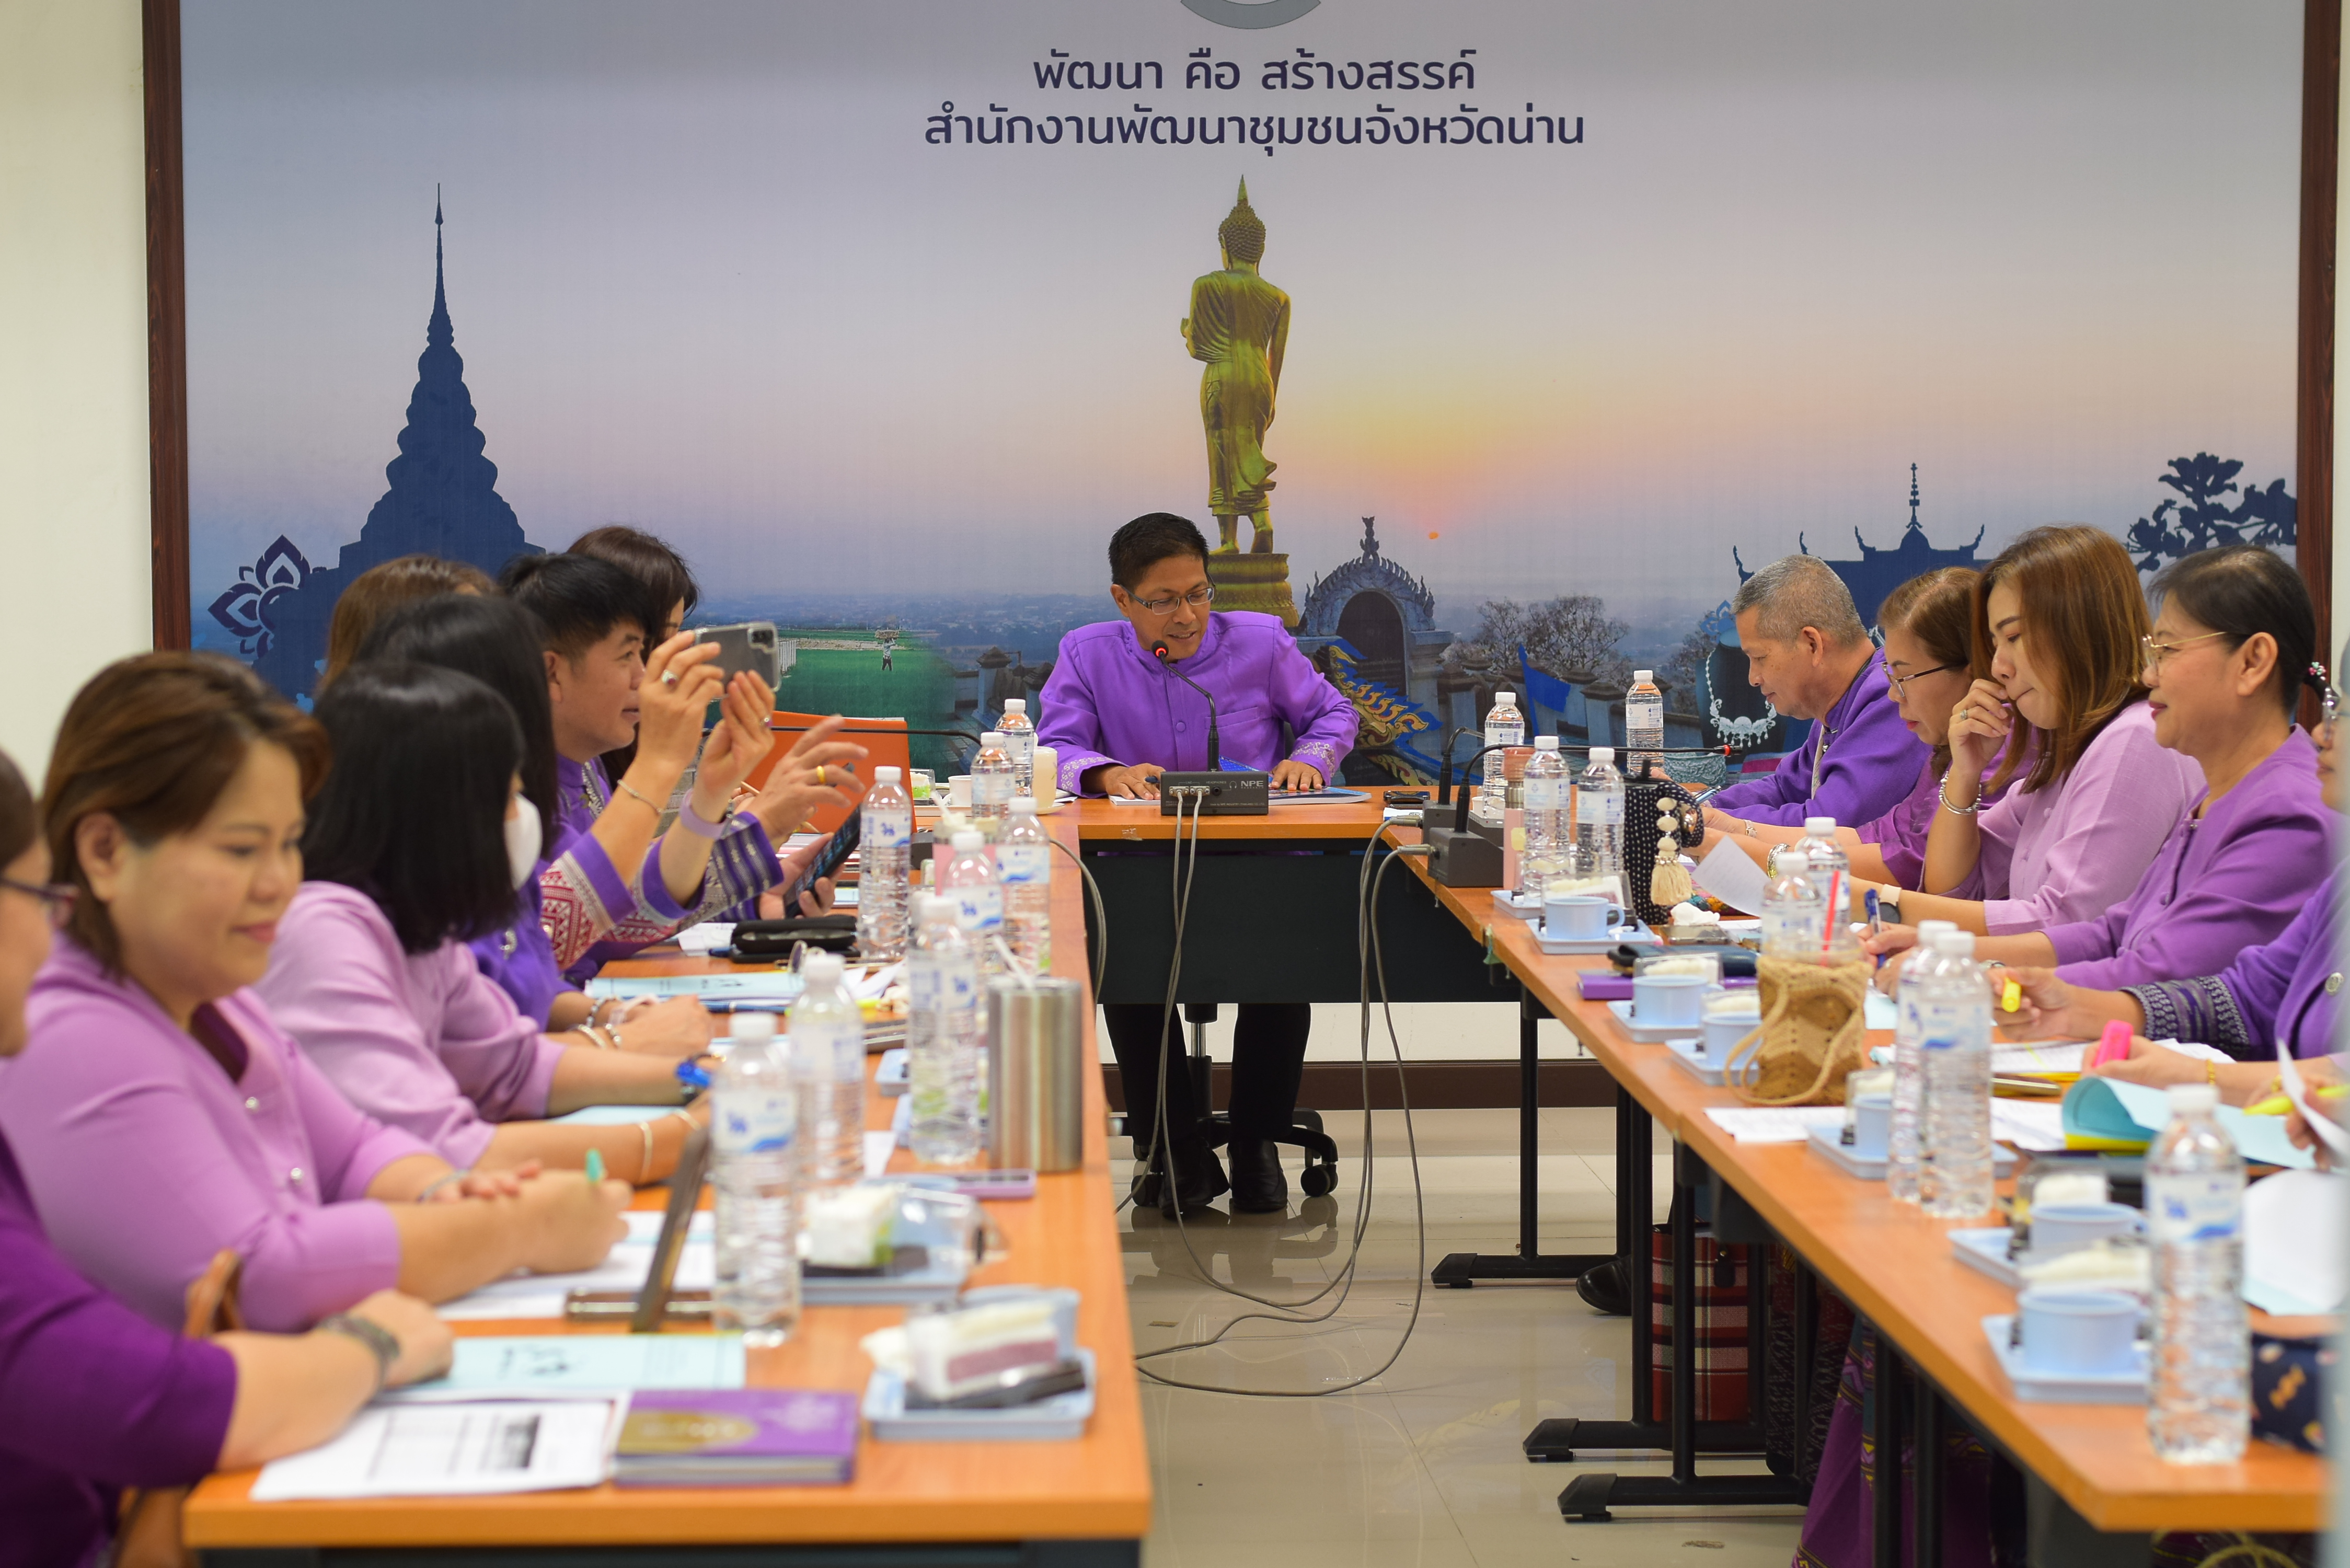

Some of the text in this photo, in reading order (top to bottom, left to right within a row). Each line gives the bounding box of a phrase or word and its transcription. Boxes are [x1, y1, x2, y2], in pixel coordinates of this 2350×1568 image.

[1033, 47, 1477, 90] พัฒนา คือ สร้างสรรค์
[925, 101, 1583, 157] สำนักงานพัฒนาชุมชนจังหวัดน่าน
